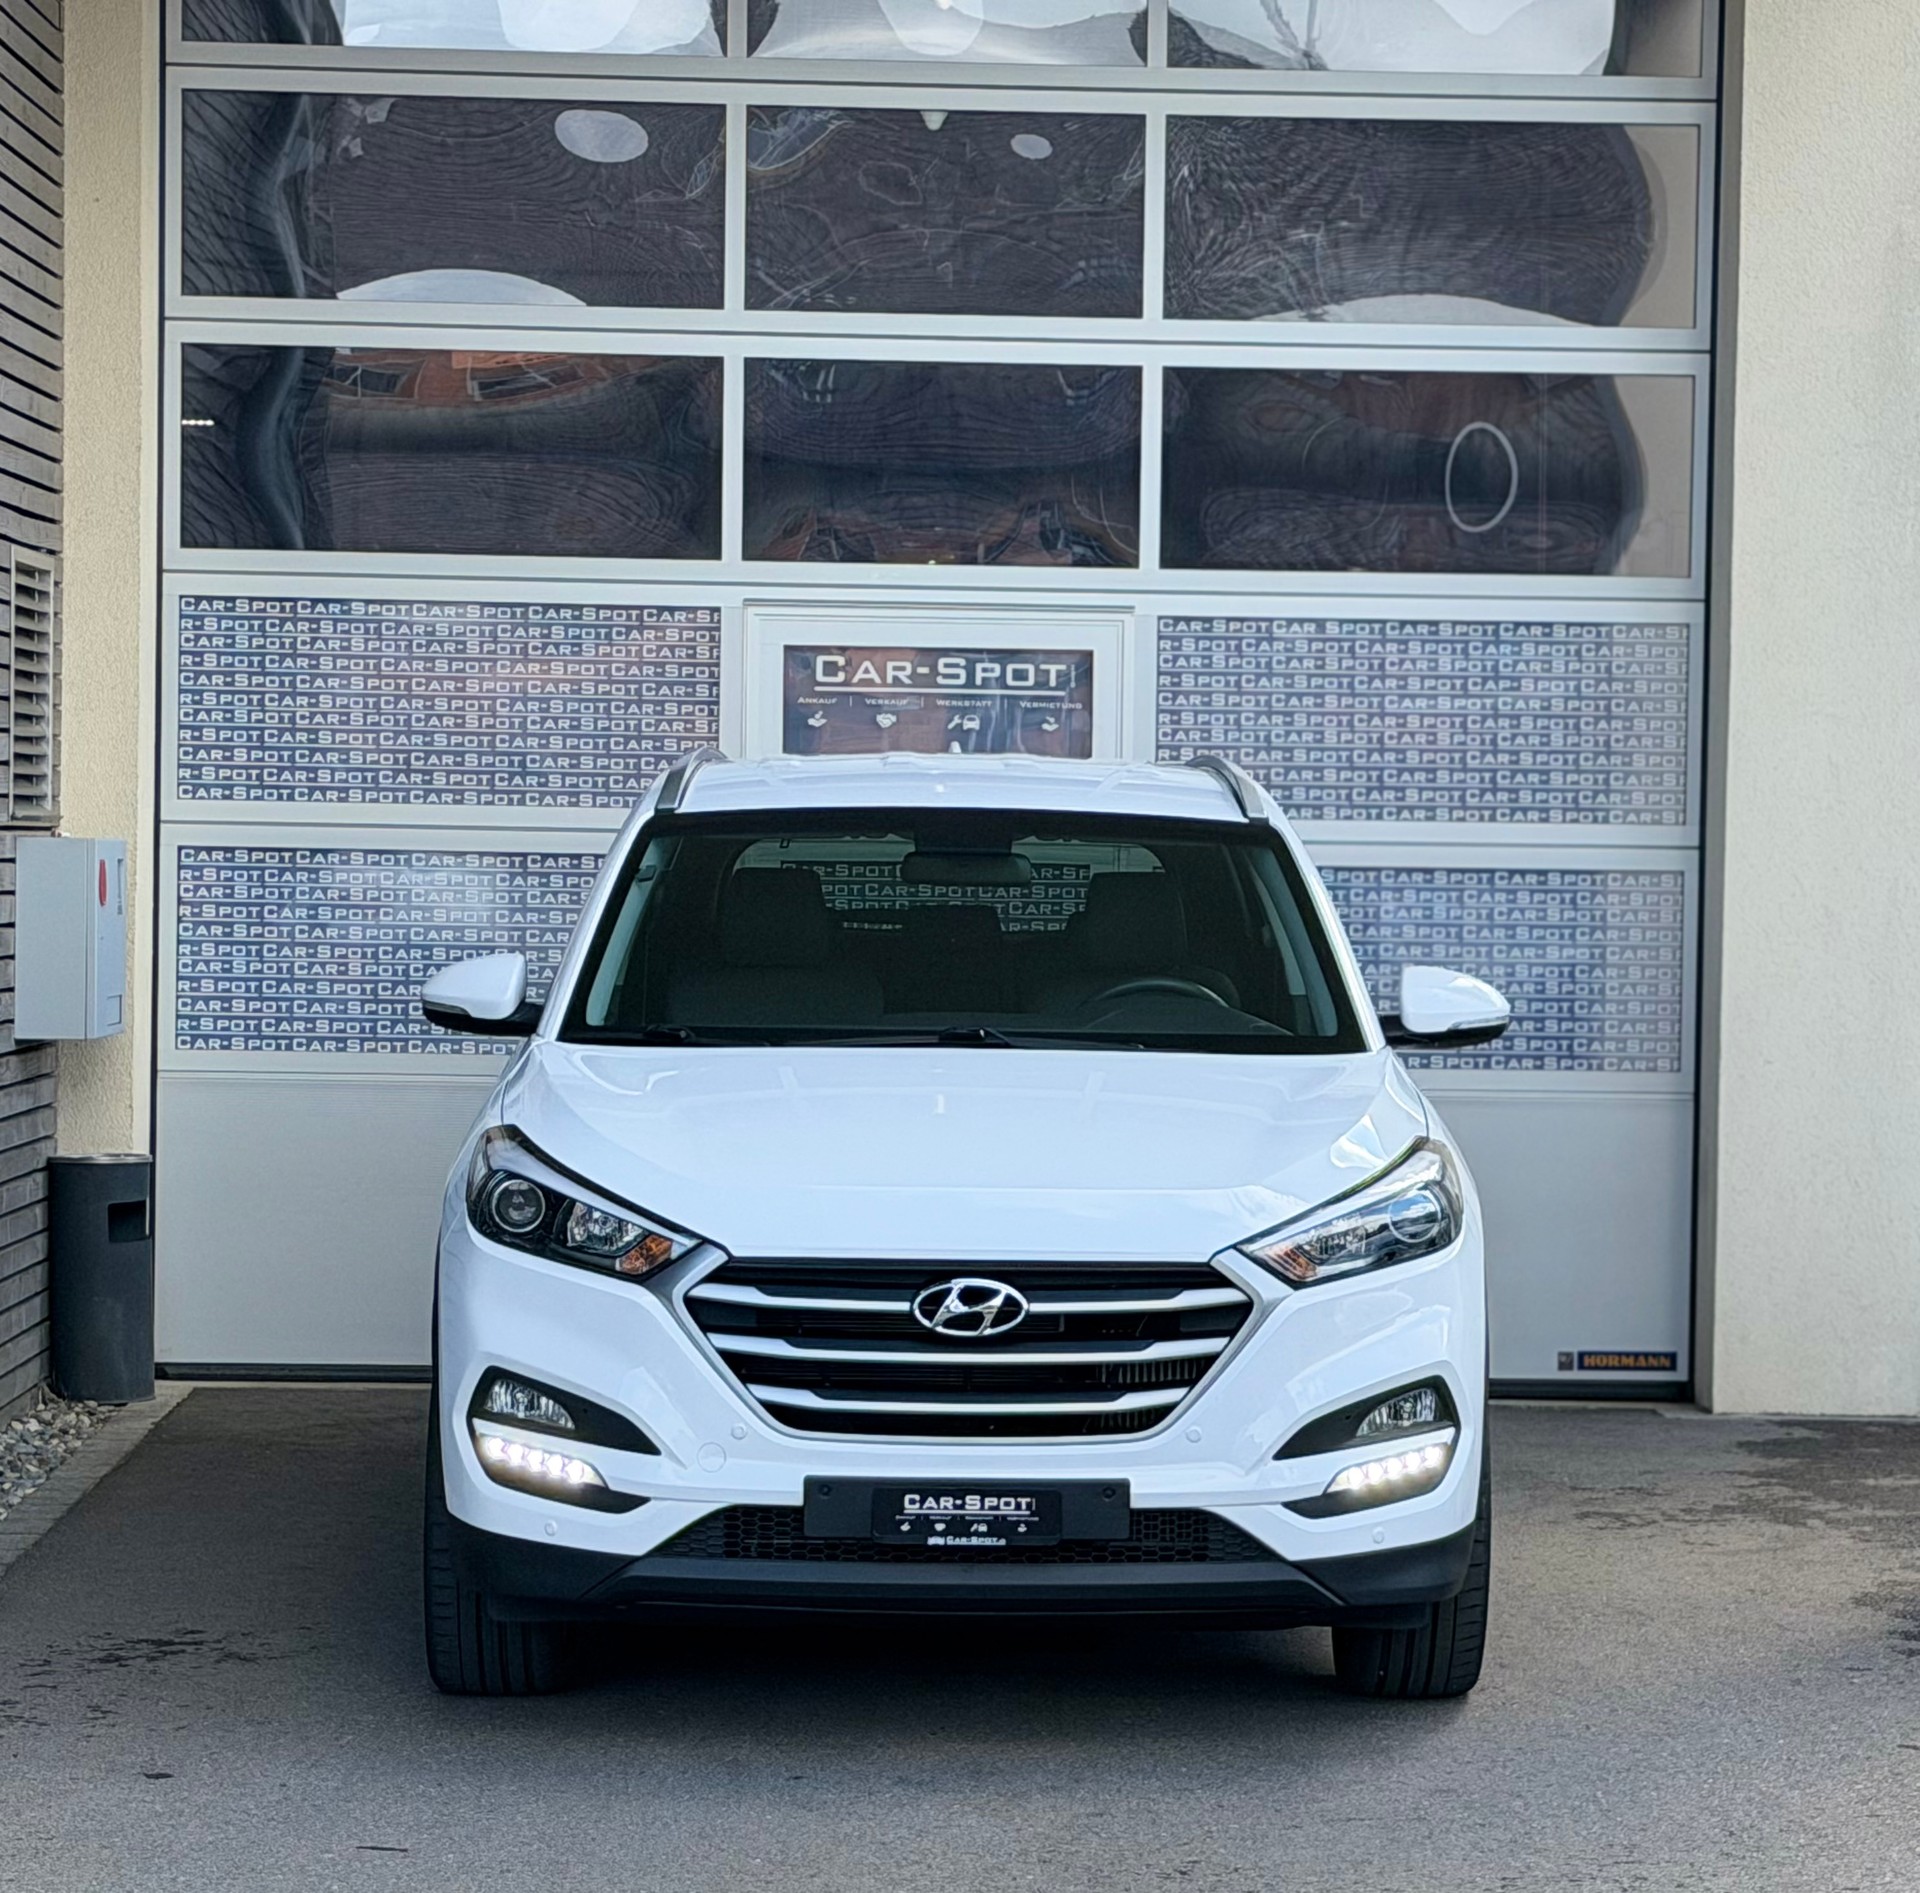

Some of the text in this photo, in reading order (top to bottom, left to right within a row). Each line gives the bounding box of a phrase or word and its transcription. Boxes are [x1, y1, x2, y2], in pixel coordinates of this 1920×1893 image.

[180, 597, 640, 620] CAR-SPOT CAR-SPOT CAR-SPOT CAR-SPOT
[265, 618, 378, 634] CAR-SPOT
[381, 621, 493, 636] CAR-SPOT
[496, 623, 608, 639] CAR-SPOT
[1273, 620, 1383, 634] CARSPOT
[180, 634, 639, 656] CAR-SPOT CAR-SPOT CAR-SPOT CAR-SPOT
[264, 654, 377, 670] CAR-SPOT
[380, 657, 493, 672] CAR-SPOT
[496, 659, 608, 675] CAR-SPOT
[815, 654, 1067, 687] CAR-SPOT
[180, 672, 639, 694] CAR-SPOT CAR-SPOT CAR-SPOT CAR-SPOT
[264, 693, 377, 708] CAR-SPOT
[380, 695, 492, 710] CAR-SPOT
[495, 697, 607, 713] CAR-SPOT
[179, 708, 639, 730] CAR-SPOT CAR-SPOT CAR-SPOT CAR-SPOT
[264, 729, 377, 744] CAR-SPOT
[380, 731, 492, 747] CAR-SPOT
[495, 733, 607, 749] CAR-SPOT
[179, 747, 638, 768] CAR-SPOT CAR-SPOT CAR-SPOT CAR-SPOT
[263, 768, 376, 783] CAR-SPOT
[379, 770, 492, 785] CAR-SPOT
[495, 772, 607, 787] CAR-SPOT
[179, 785, 292, 801] CAR-SPOT
[295, 787, 408, 803] CAR-SPOT
[411, 790, 523, 805] CAR-SPOT
[179, 847, 523, 868] CAR-SPOT CAR-SPOT CAR-SPOT
[263, 869, 376, 884] CAR-SPOT
[379, 871, 491, 886] CAR-SPOT
[495, 873, 593, 889] CAR-SPO
[179, 884, 523, 904] CAR-SPOT CAR-SPOT CAR-SPOT
[263, 904, 376, 920] CAR-SPOT
[379, 907, 491, 922] CAR-SPOT
[179, 922, 523, 942] CAR-SPOT CAR-SPOT CAR-SPOT
[263, 943, 375, 958] CAR-SPOT
[178, 958, 407, 976] CAR-SPOT CAR-SPOT
[262, 979, 375, 994] CAR-SPOT
[178, 997, 406, 1014] CAR-SPOT CAR-SPOT
[262, 1018, 374, 1033] CAR-SPOT
[177, 1035, 290, 1050] CAR-SPOT
[293, 1037, 406, 1052] CAR-SPOT
[904, 1494, 1031, 1510] CAR-SPOT
